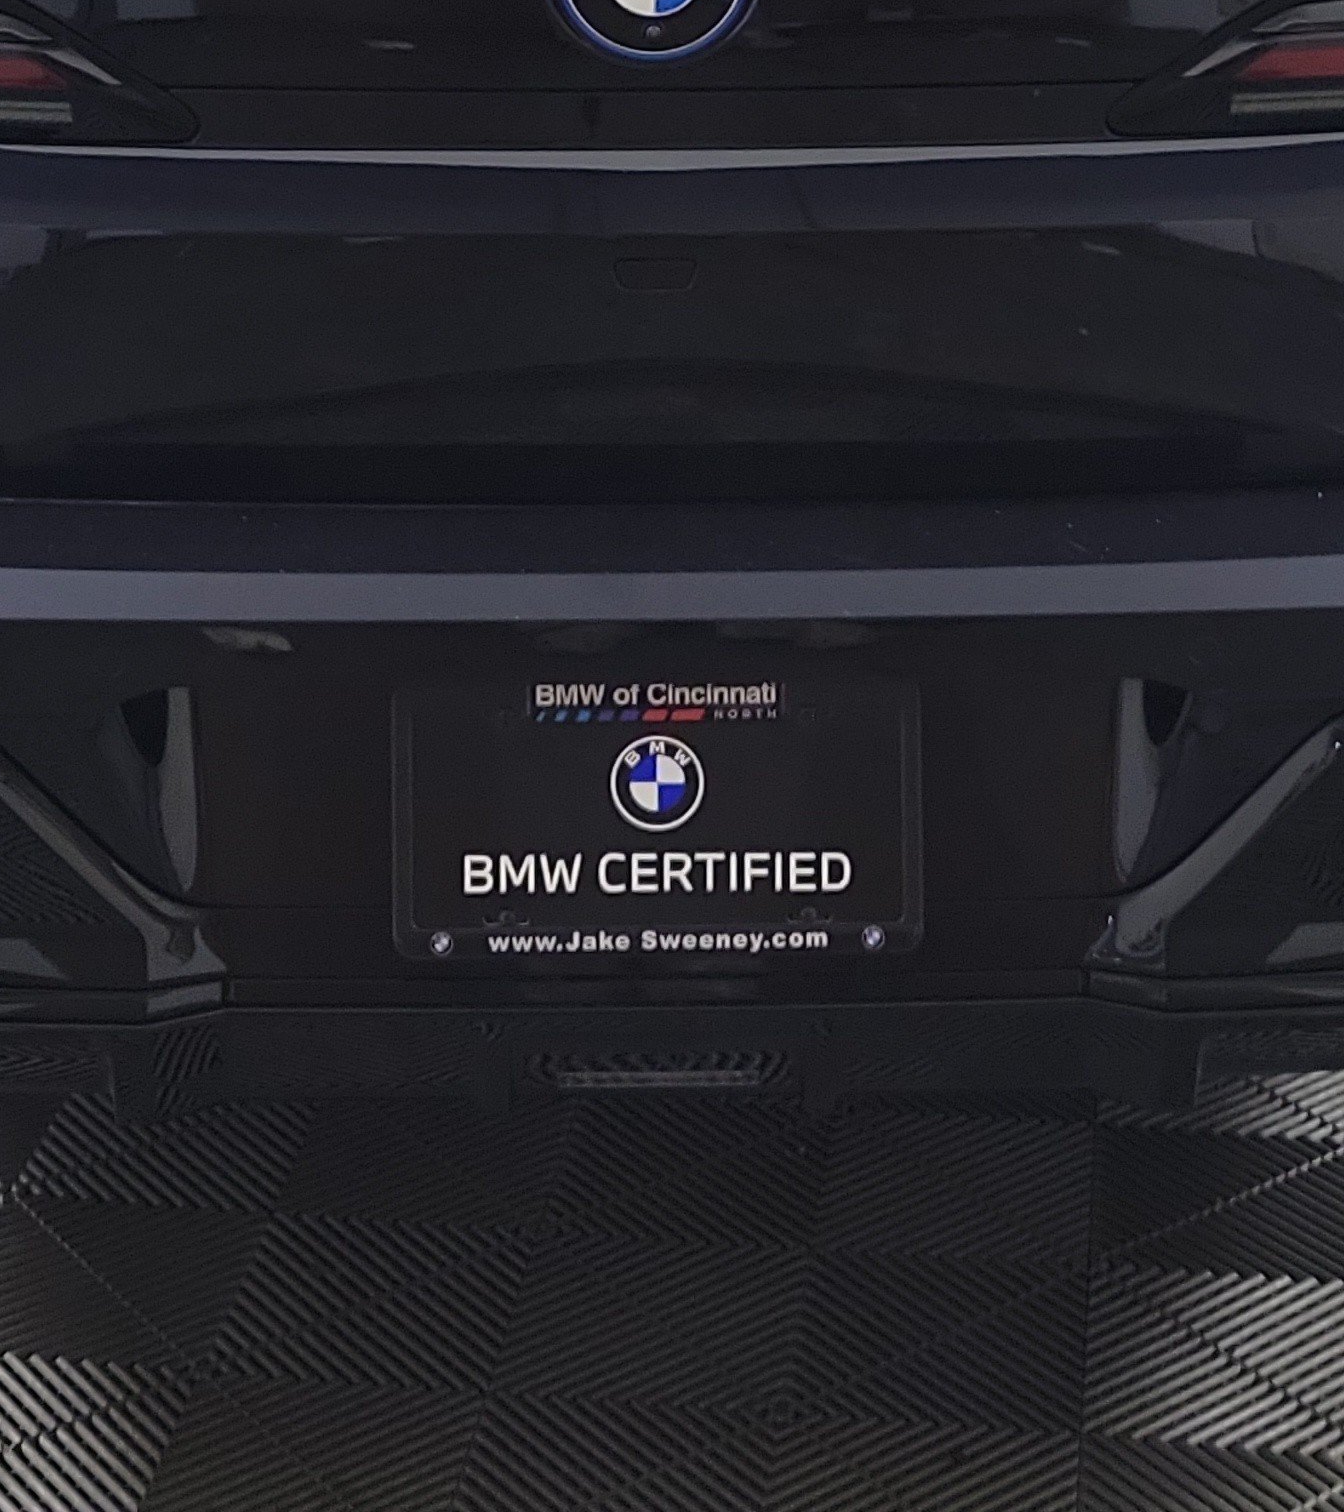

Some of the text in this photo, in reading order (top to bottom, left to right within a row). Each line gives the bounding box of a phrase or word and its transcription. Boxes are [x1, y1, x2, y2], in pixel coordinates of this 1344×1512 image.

[534, 681, 778, 707] BMW of Cincinnati
[712, 707, 778, 721] NORTH
[623, 740, 693, 769] BMW
[462, 851, 853, 895] BMW CERTIFIED
[487, 928, 830, 953] www.Jake Sweeney.com
